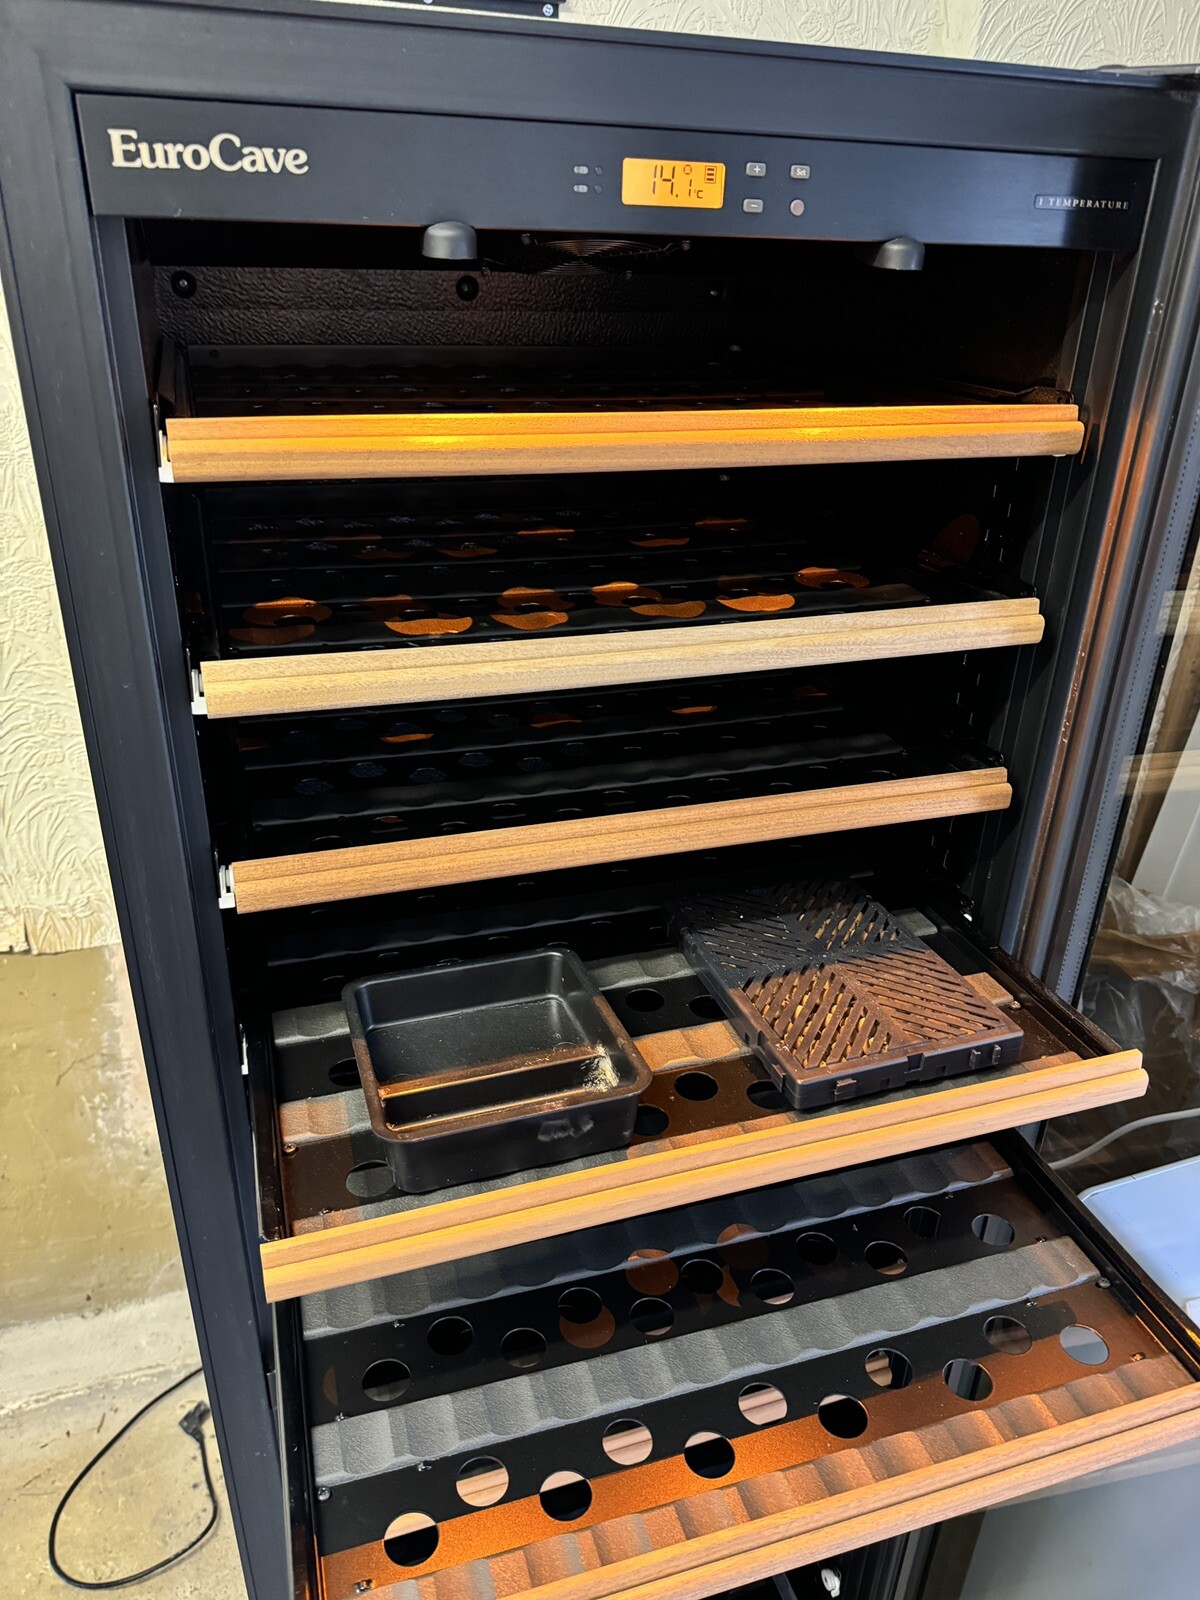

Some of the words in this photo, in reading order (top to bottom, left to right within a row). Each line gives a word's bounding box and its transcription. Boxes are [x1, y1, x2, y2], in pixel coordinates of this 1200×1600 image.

[107, 128, 309, 174] EuroCave
[796, 168, 807, 176] Set
[1048, 198, 1129, 210] TEMPERATURE
